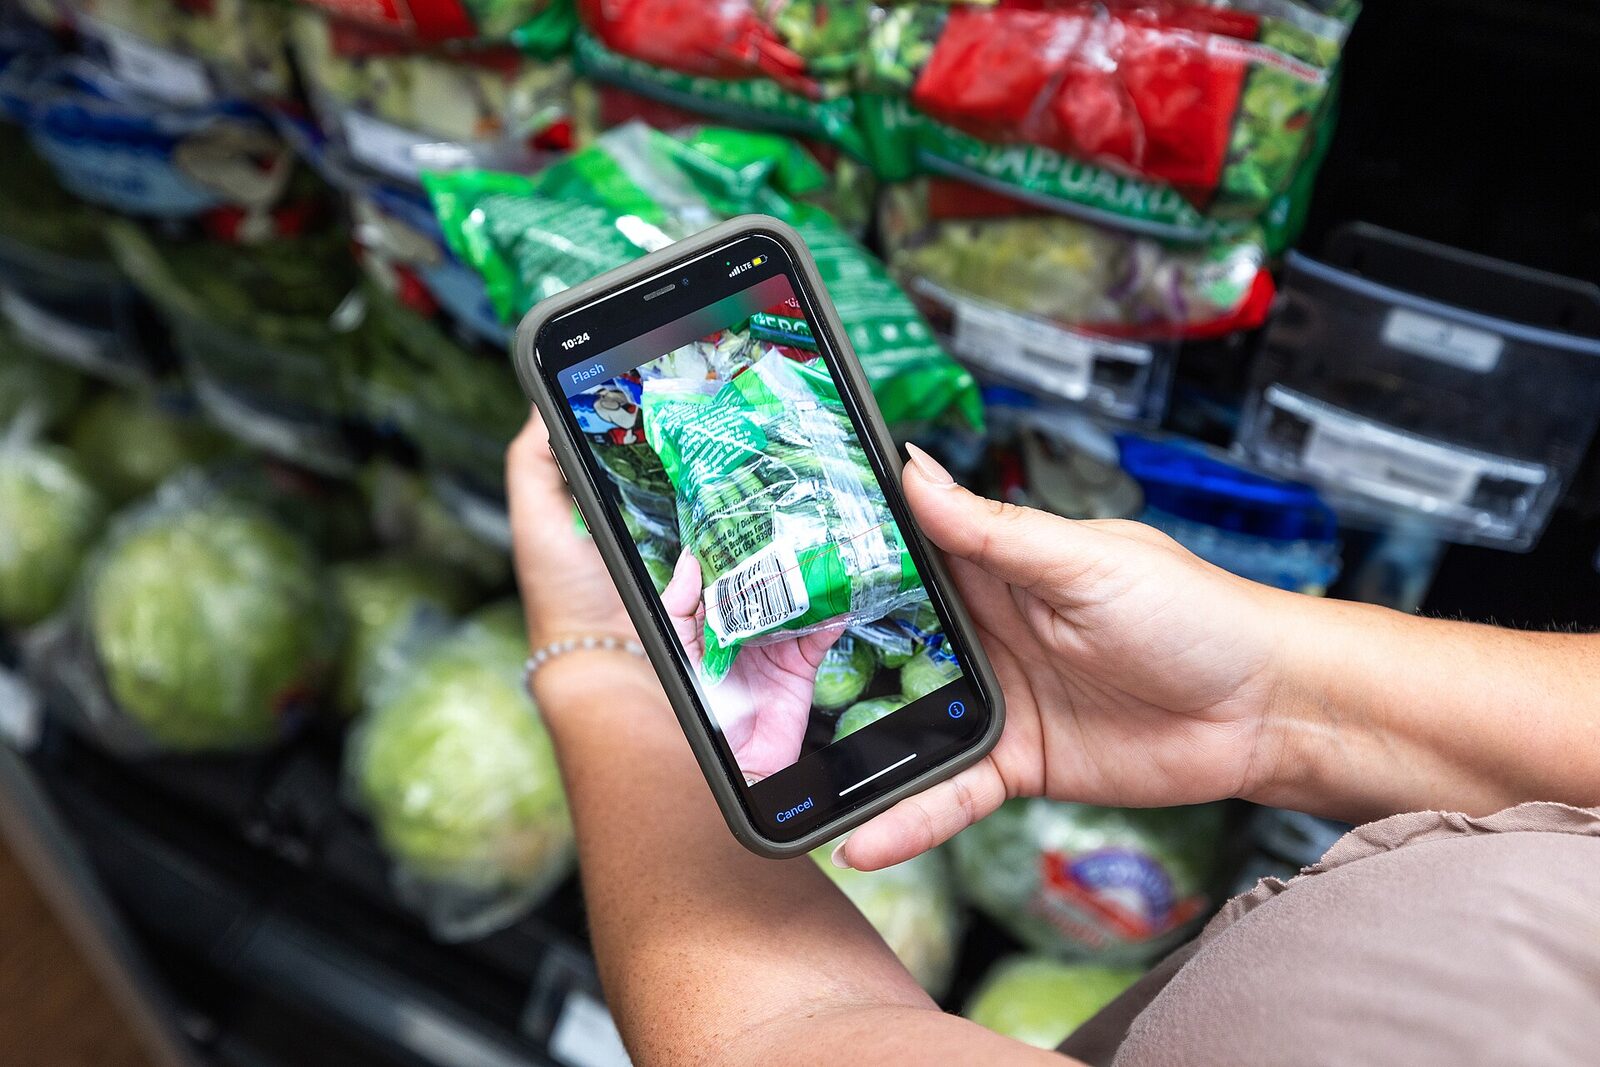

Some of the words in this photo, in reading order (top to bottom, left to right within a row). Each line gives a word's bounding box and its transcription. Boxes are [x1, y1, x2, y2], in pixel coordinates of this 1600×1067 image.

[740, 261, 753, 272] LTE
[561, 332, 590, 350] 10:24
[571, 364, 605, 384] Flash
[775, 797, 814, 824] Cancel
